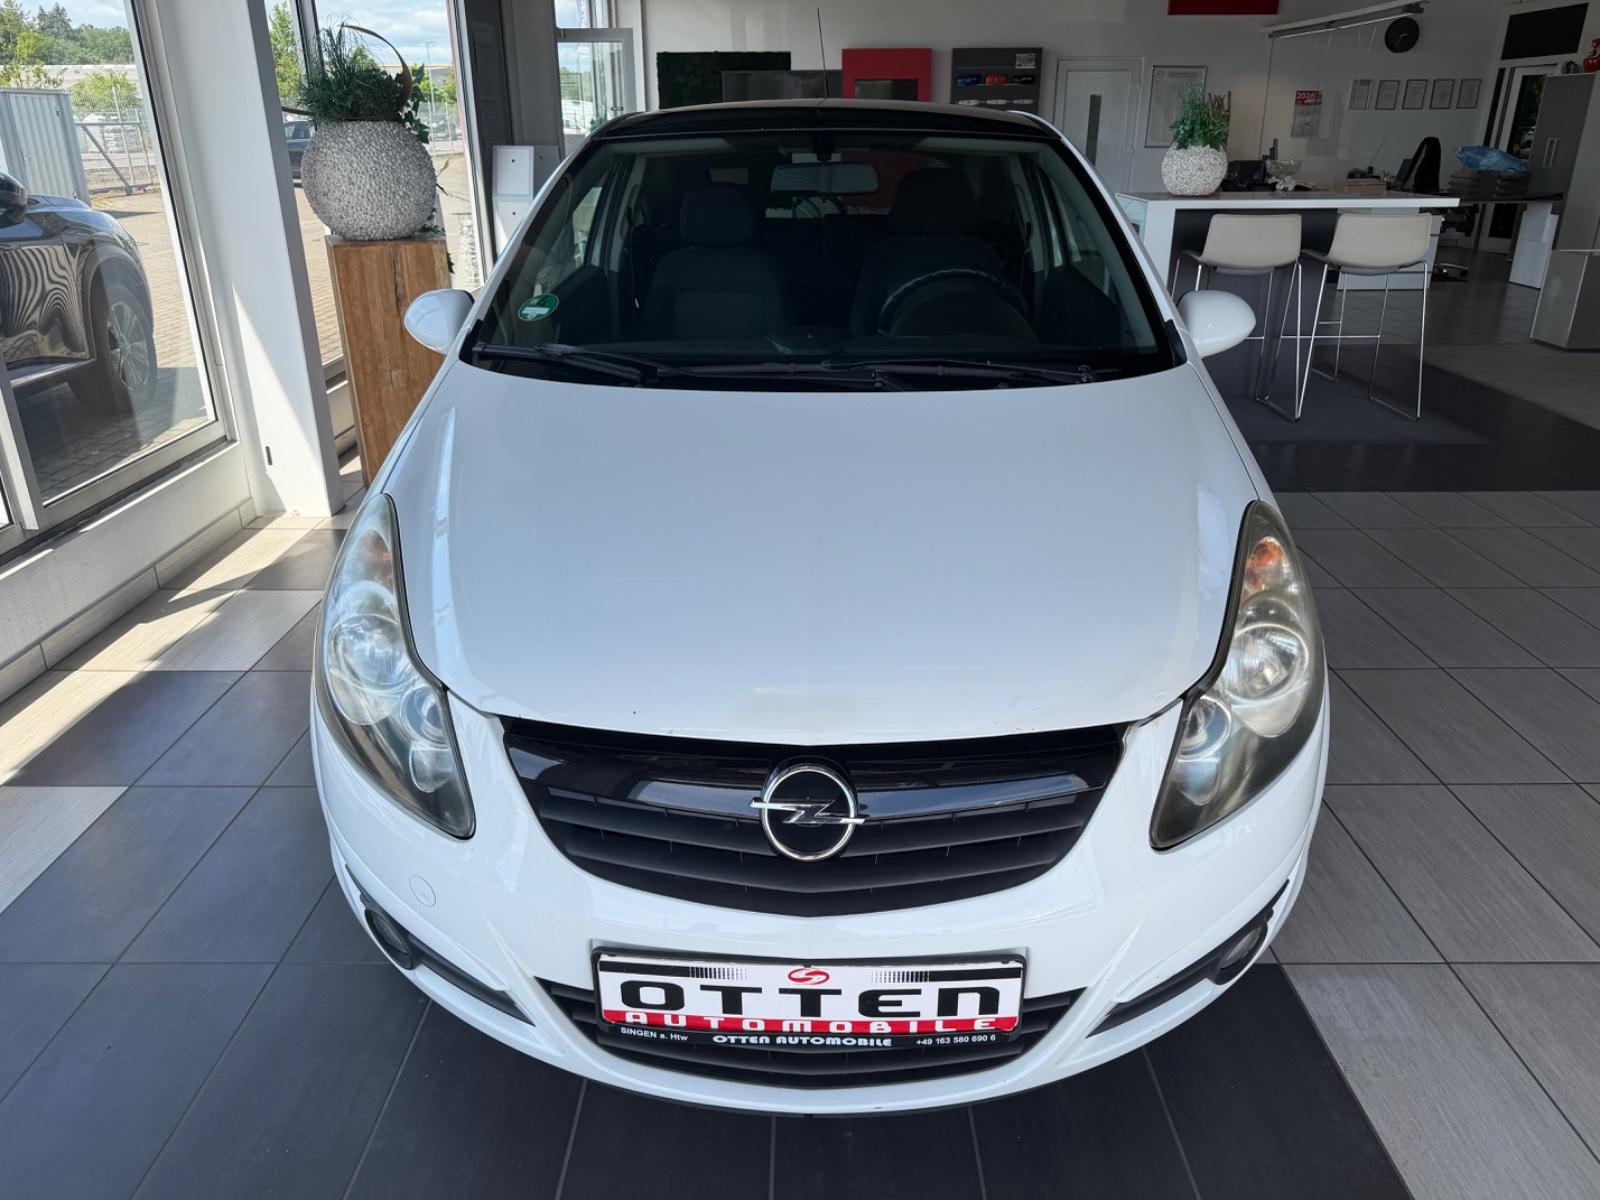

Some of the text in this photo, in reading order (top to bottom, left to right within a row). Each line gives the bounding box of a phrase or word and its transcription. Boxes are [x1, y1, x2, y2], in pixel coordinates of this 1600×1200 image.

[620, 979, 1000, 1018] OTTEN
[625, 1012, 997, 1033] AUTOMOBILE
[620, 1026, 657, 1039] SINGEN
[971, 1034, 988, 1042] 690
[712, 1035, 892, 1046] OTTEN AUTOMOBILE
